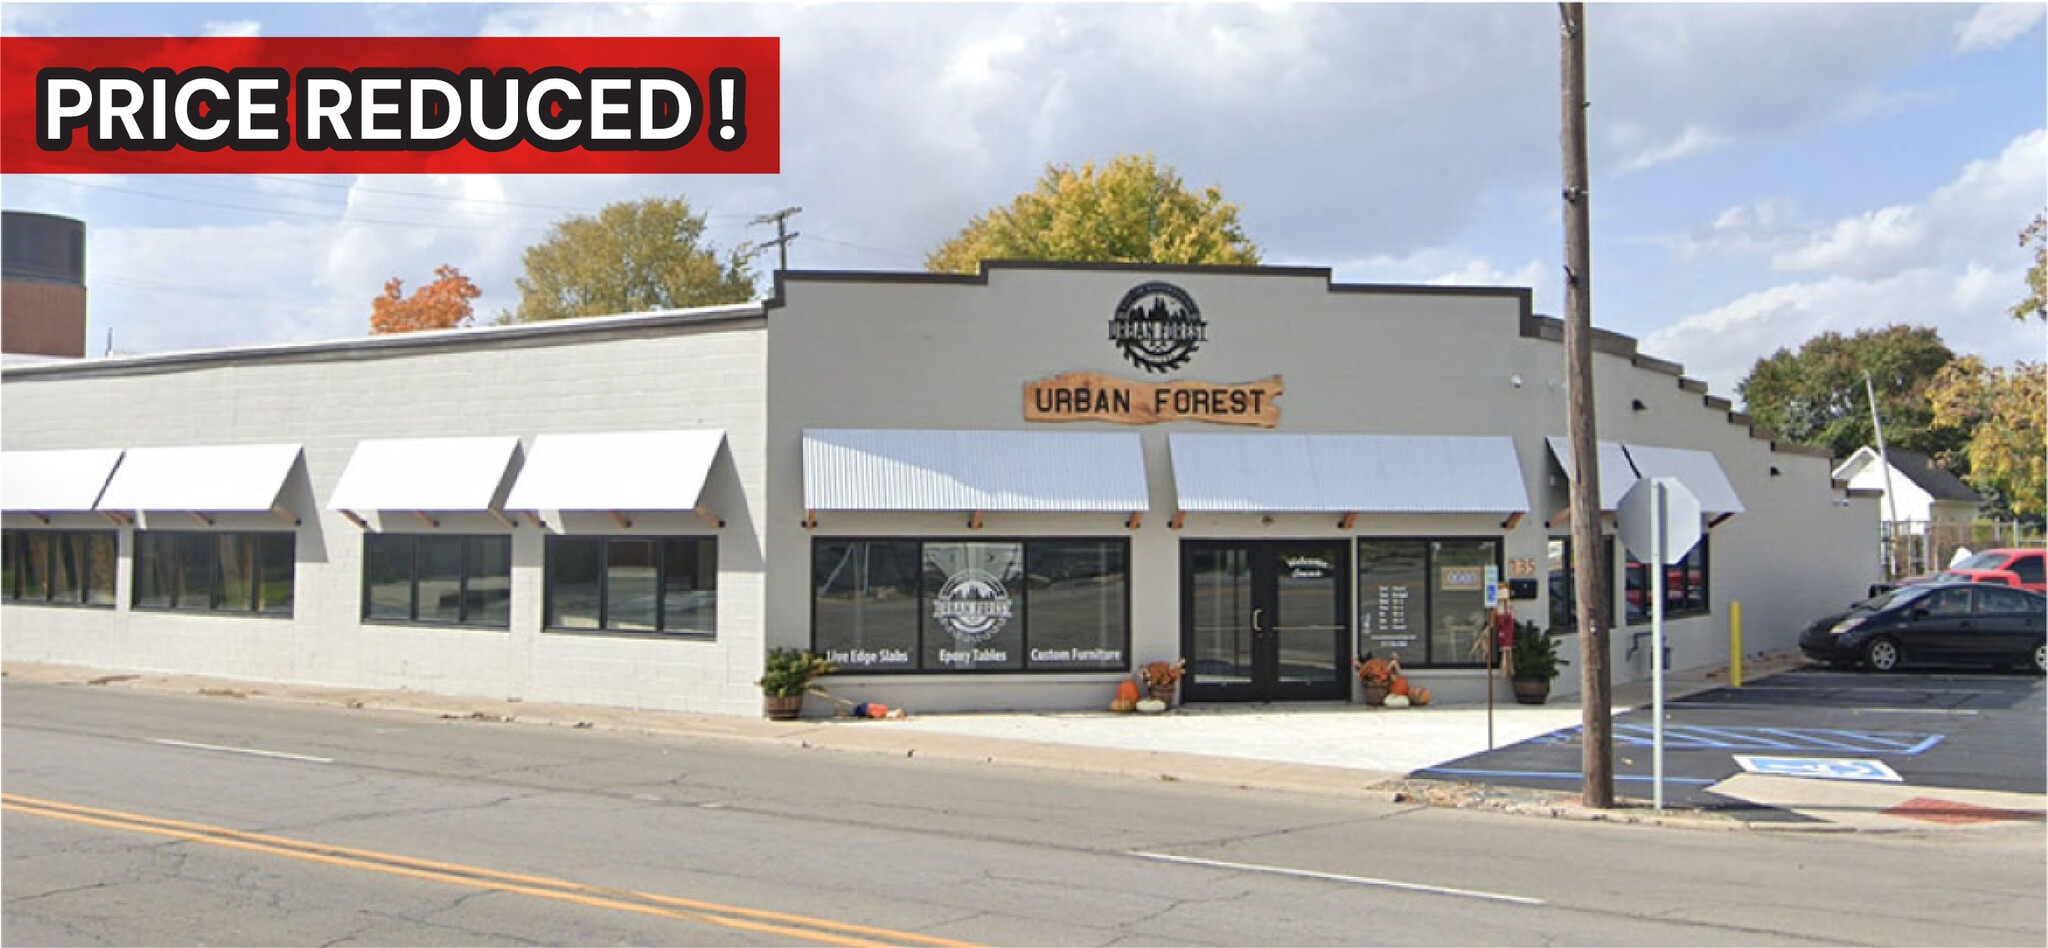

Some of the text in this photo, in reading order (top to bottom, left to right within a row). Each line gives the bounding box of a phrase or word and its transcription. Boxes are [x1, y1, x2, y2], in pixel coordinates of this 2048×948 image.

[1035, 387, 1265, 414] URBAN FOREST
[850, 648, 878, 666] Edge
[879, 648, 909, 662] Slabs
[939, 647, 1007, 666] Epoxy Tables
[1030, 647, 1122, 662] Custom Furniture
